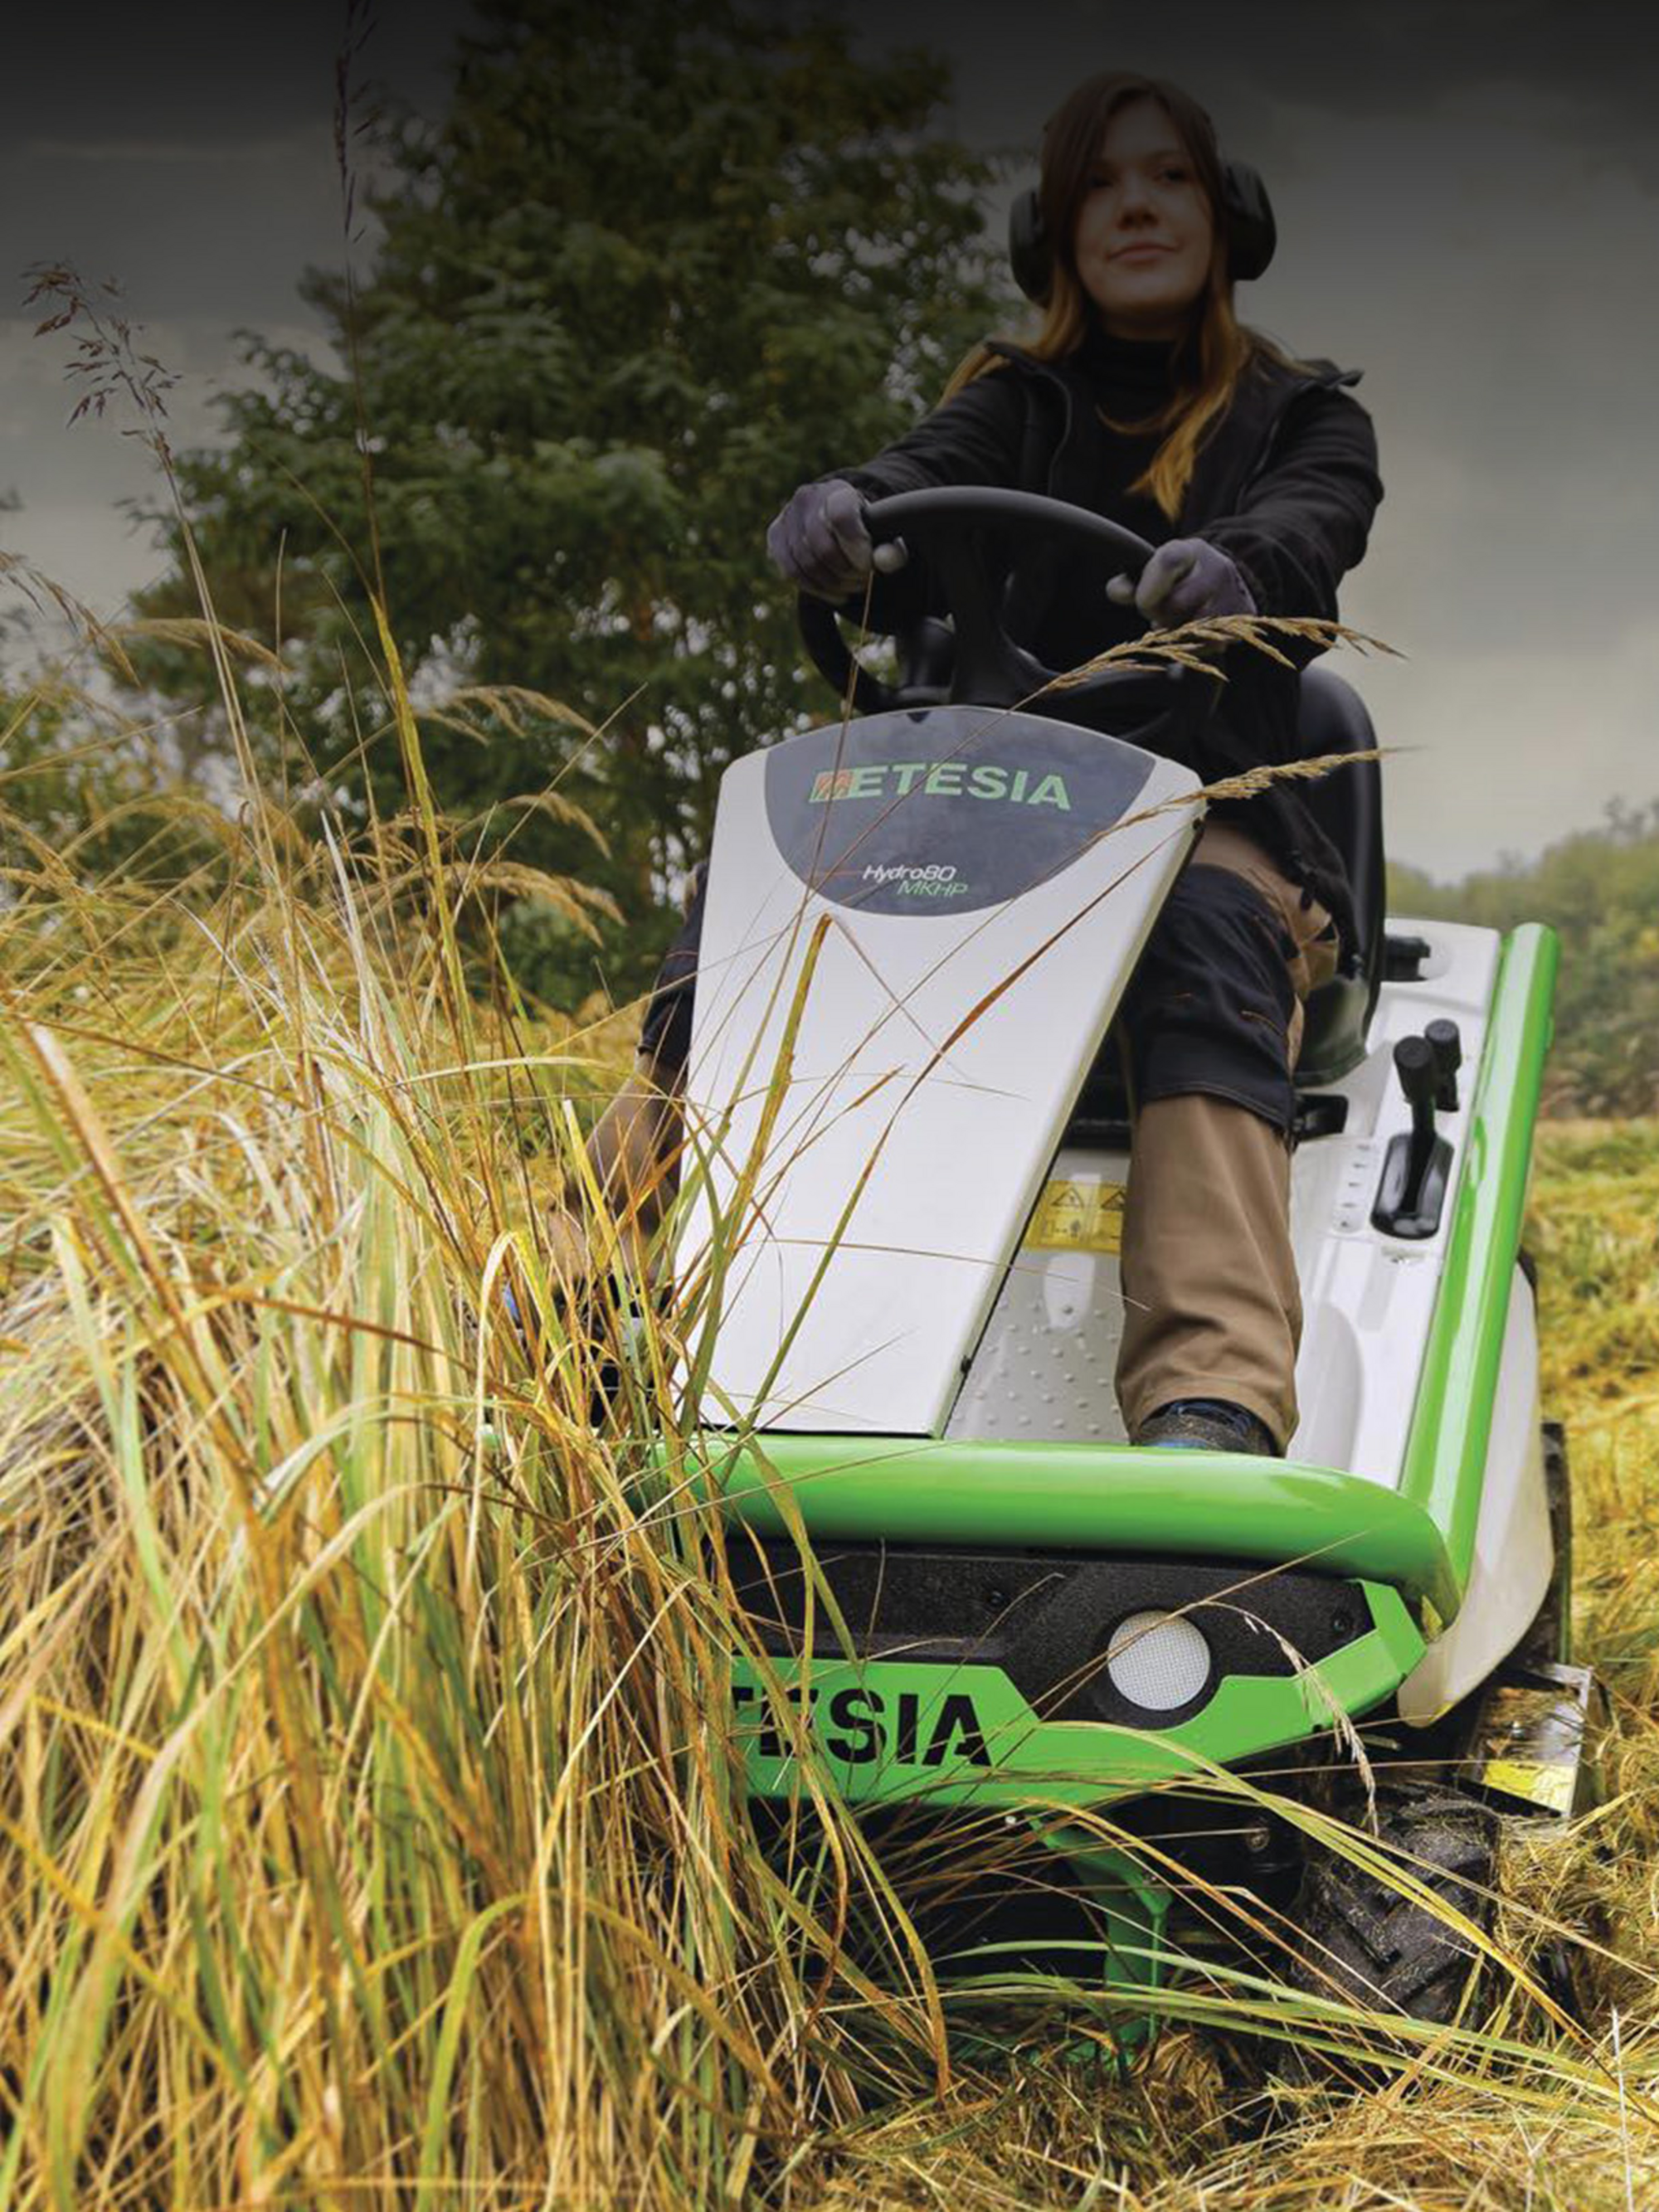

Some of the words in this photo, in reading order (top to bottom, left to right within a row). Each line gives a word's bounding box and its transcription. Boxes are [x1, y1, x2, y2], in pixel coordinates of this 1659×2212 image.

[846, 762, 1071, 811] ETESIA
[862, 863, 957, 884] Hydro80
[897, 879, 969, 897] MKHP
